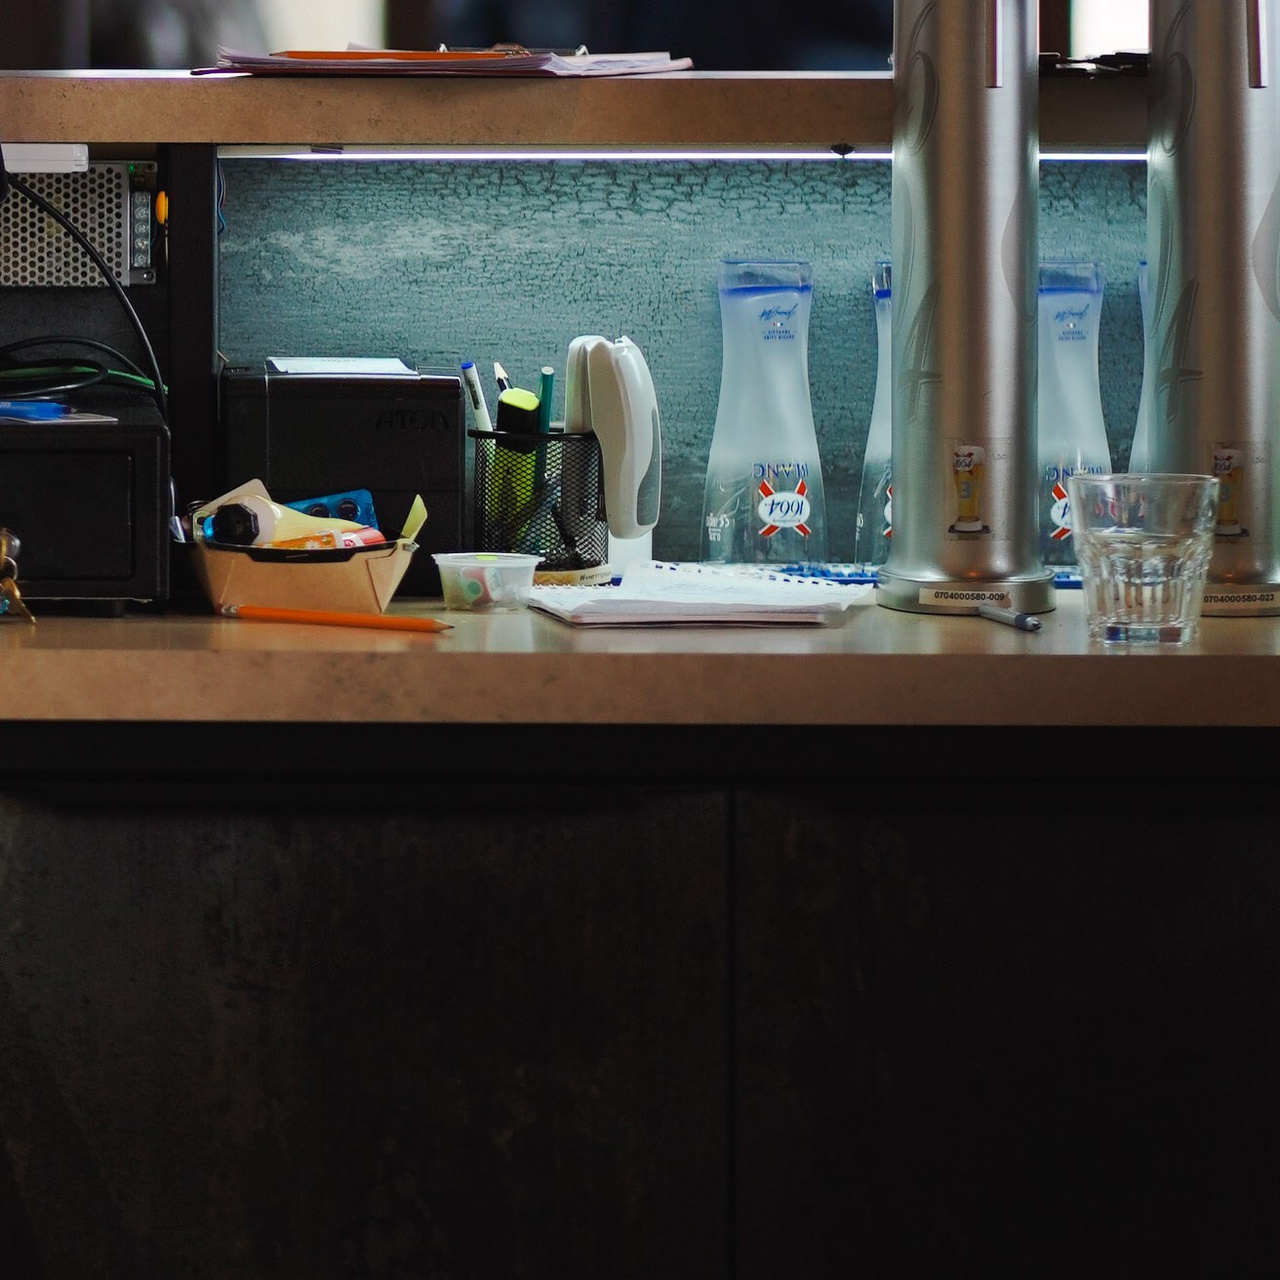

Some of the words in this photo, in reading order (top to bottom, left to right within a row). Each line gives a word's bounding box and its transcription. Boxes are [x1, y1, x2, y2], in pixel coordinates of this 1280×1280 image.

[767, 500, 805, 518] 1664
[934, 591, 1005, 601] 0704000580-009
[1203, 593, 1275, 604] 0704000580-023
